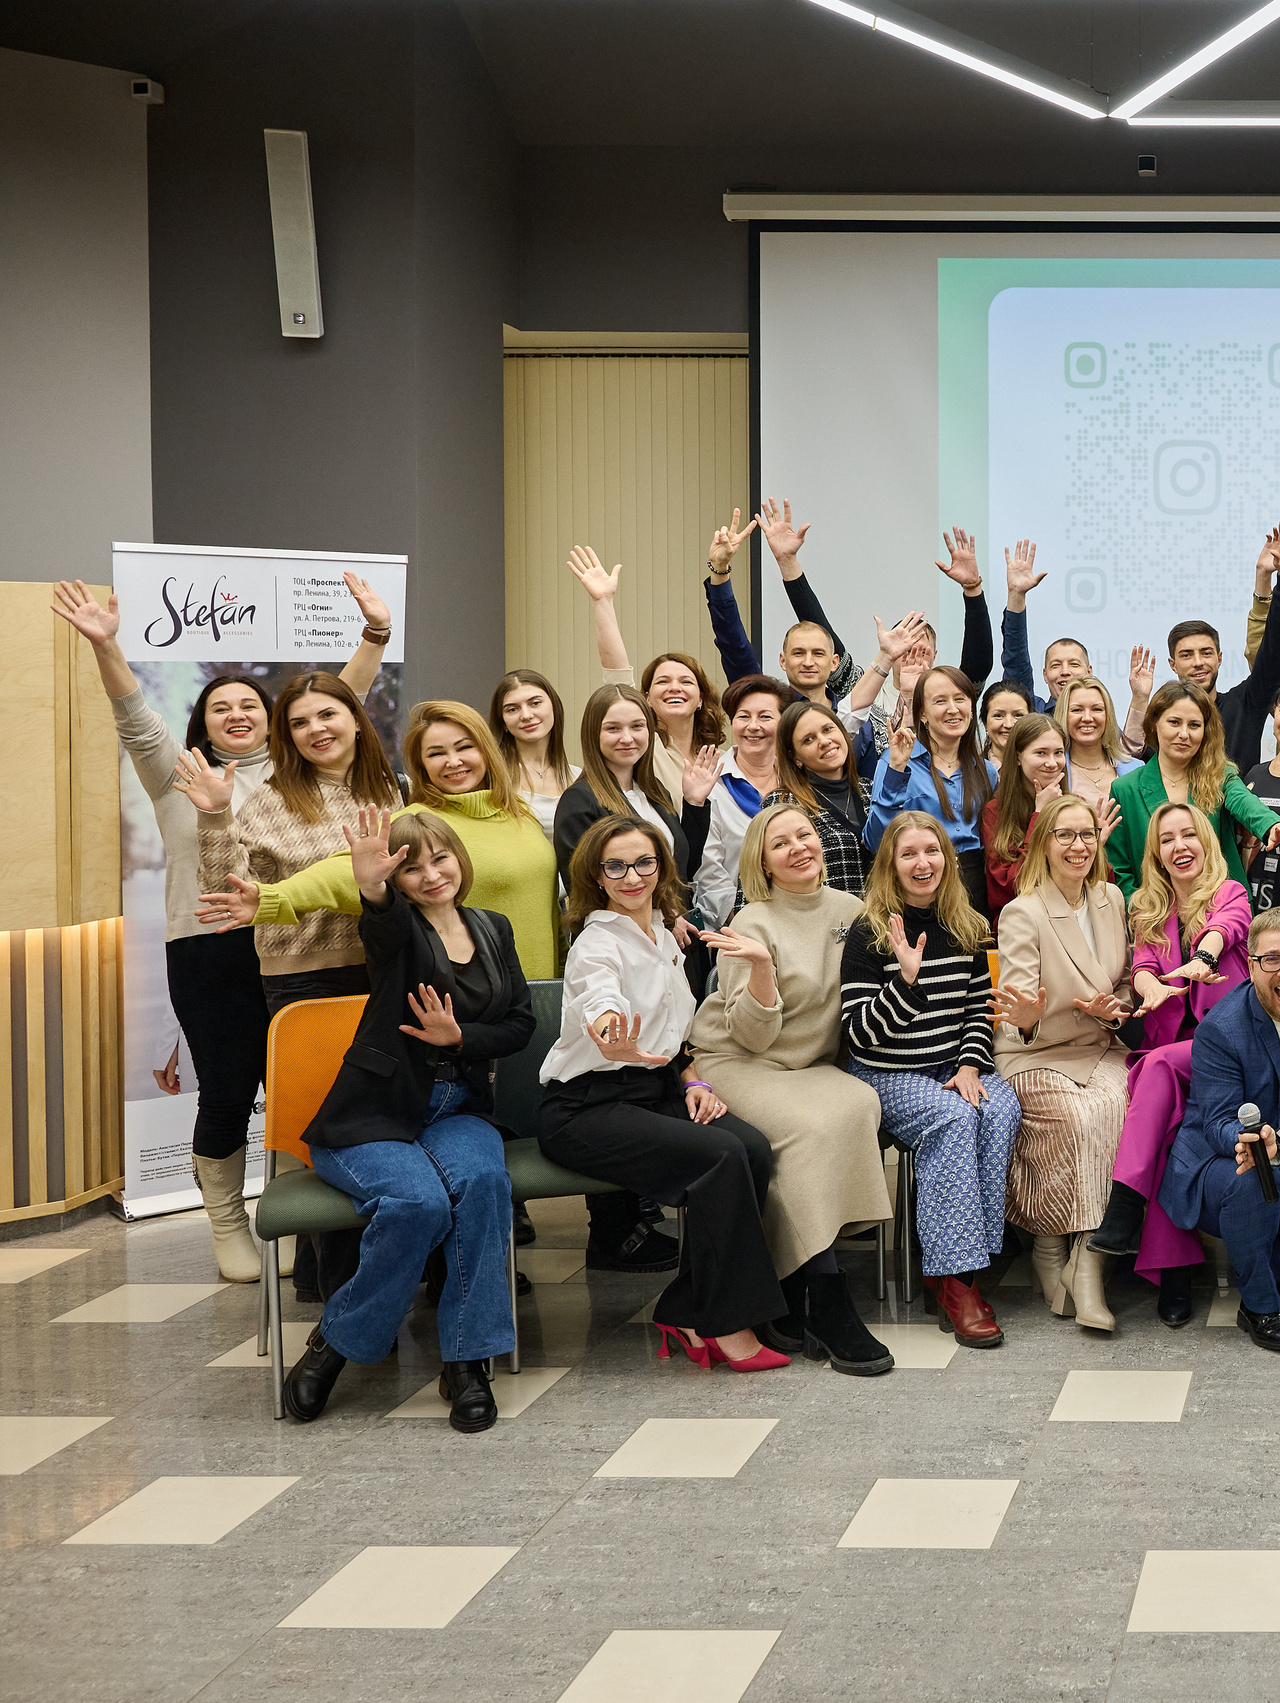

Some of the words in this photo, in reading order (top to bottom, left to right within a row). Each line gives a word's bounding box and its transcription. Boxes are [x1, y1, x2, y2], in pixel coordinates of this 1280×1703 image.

[293, 577, 306, 586] ТОЦ
[293, 590, 303, 598] пр.
[304, 589, 331, 598] Ленина,
[332, 590, 342, 598] 39,
[144, 574, 256, 647] Stefan
[294, 603, 306, 611] ТРЦ
[307, 603, 333, 611] «Огни»
[294, 629, 307, 637] ТРЦ
[308, 629, 344, 638] «Пионер»
[306, 640, 332, 648] Ленина,
